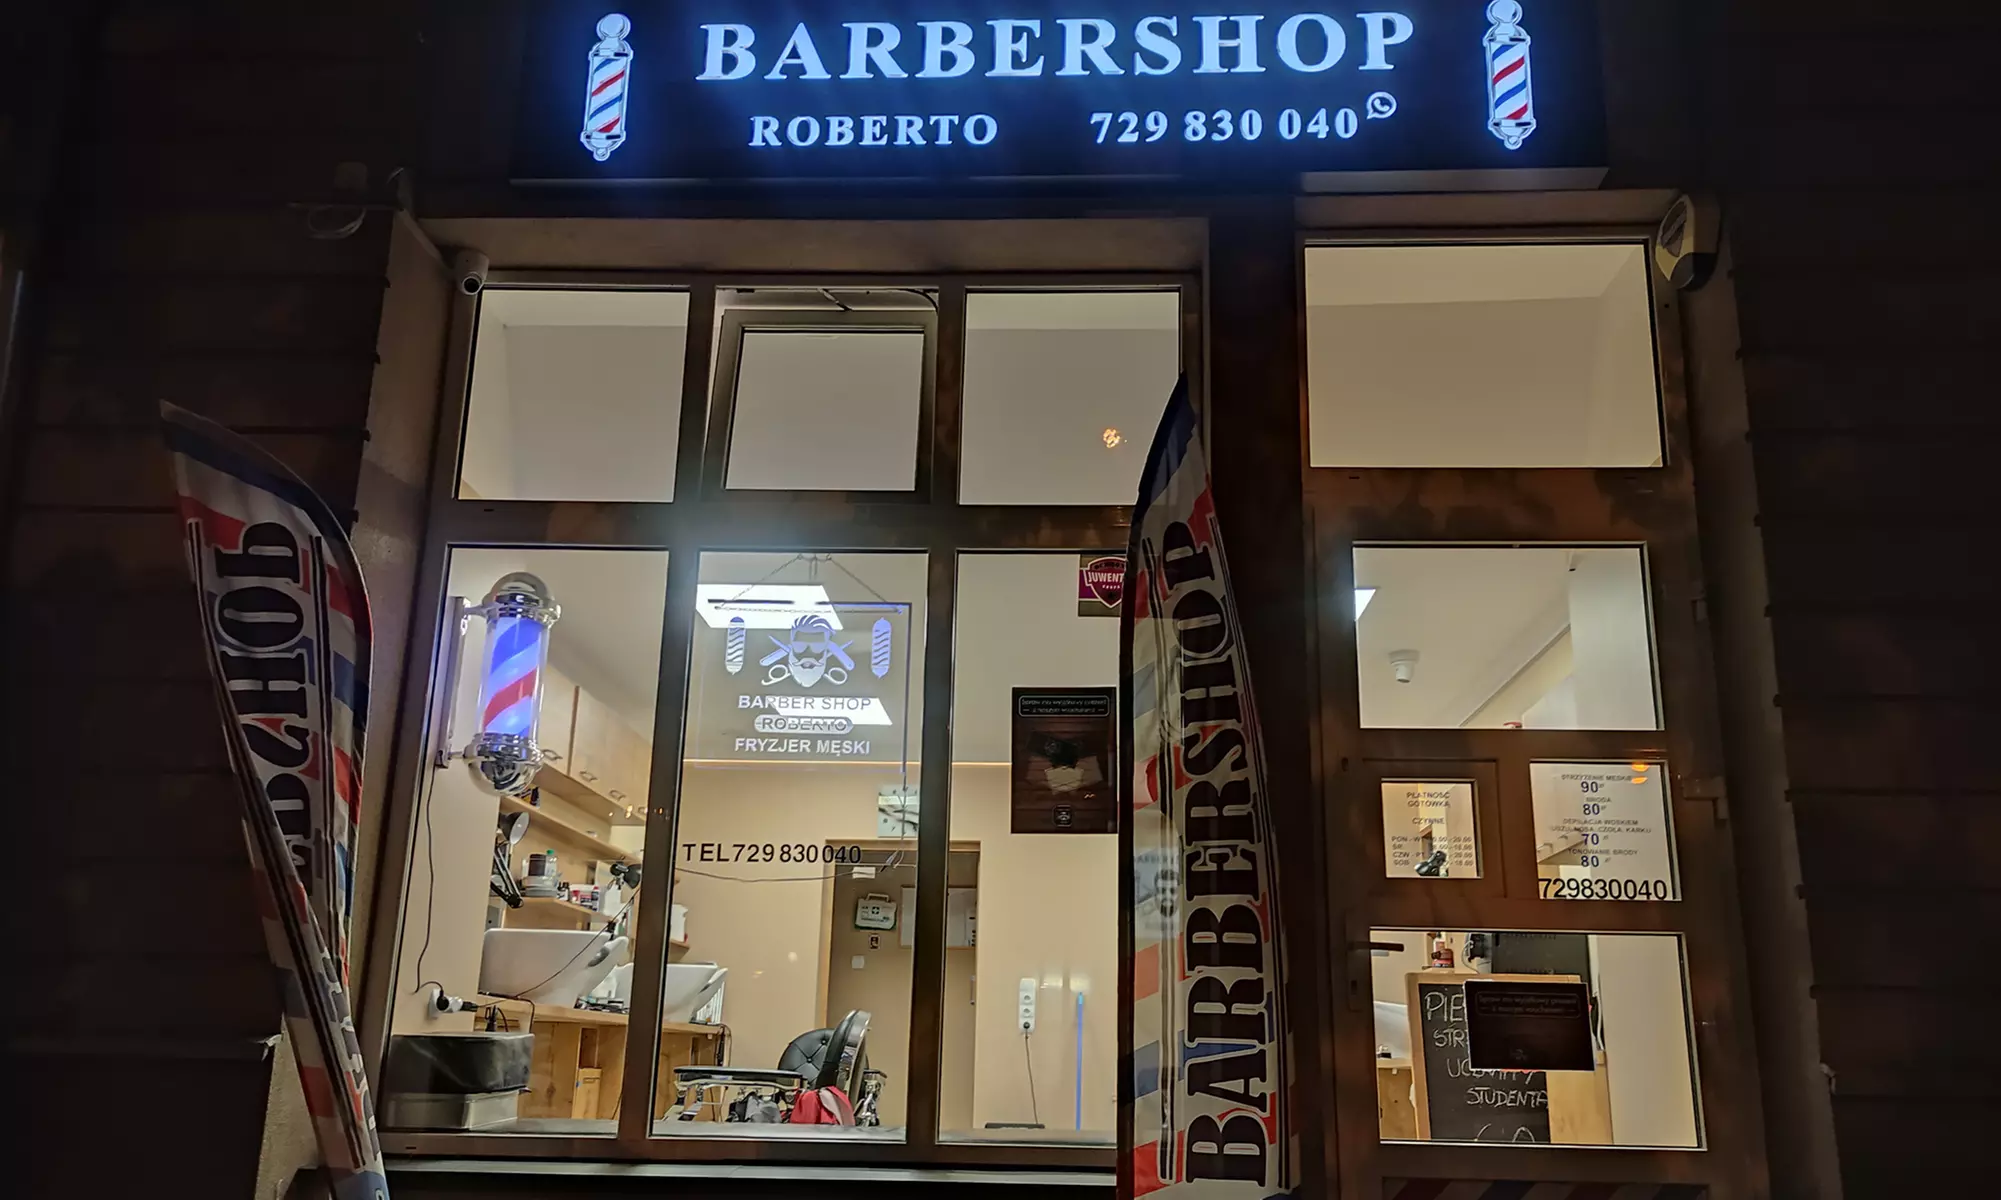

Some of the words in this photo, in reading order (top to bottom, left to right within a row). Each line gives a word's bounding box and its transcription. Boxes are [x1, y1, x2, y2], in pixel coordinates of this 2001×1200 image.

[695, 11, 1414, 81] BARBERSHOP
[748, 113, 998, 148] ROBERTO
[1090, 110, 1168, 144] 729
[1184, 109, 1263, 142] 830
[1278, 107, 1359, 140] 040
[1088, 571, 1125, 583] JUWENT
[737, 695, 815, 710] BARBER
[821, 696, 871, 711] SHOP
[761, 716, 847, 732] ROBERTO
[734, 737, 811, 753] FRYZJER
[815, 739, 870, 757] MĘSKI
[1581, 781, 1599, 793] 90
[1583, 803, 1600, 815] 80
[1581, 833, 1600, 845] 70
[1162, 519, 1271, 1187] BARBERSHOP
[1581, 855, 1599, 867] 80
[1538, 878, 1668, 900] 729830040
[1424, 991, 1464, 1022] PIE
